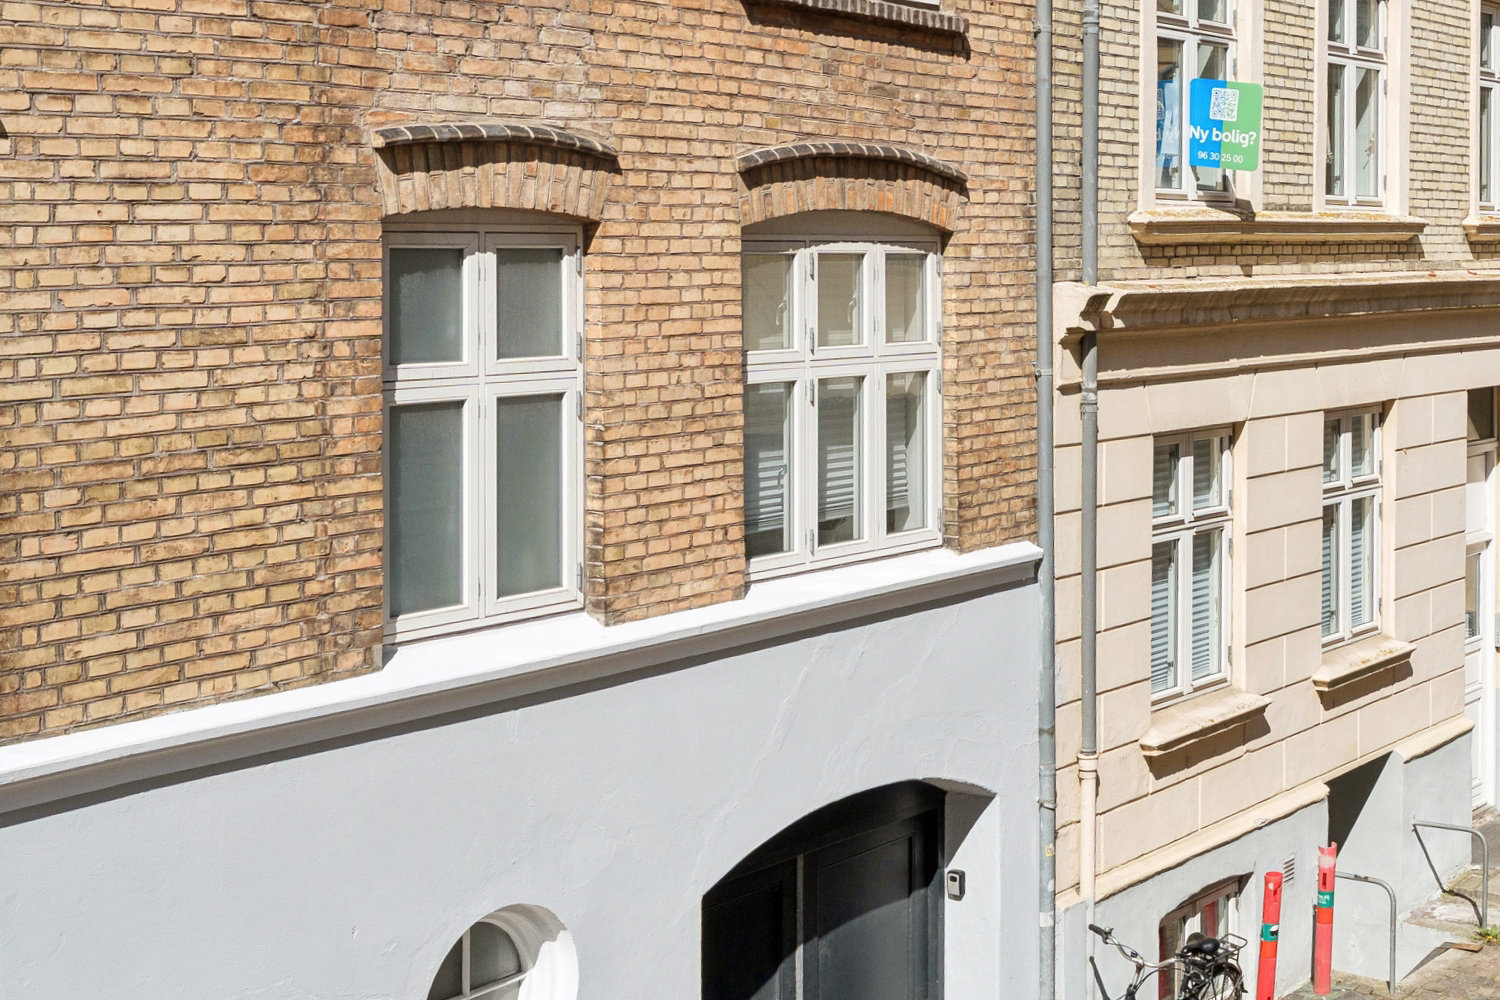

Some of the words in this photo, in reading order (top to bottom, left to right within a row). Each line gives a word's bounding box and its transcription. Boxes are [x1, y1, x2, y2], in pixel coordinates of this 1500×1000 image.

[1189, 125, 1209, 143] Ny
[1212, 127, 1256, 147] bolig?
[1197, 151, 1208, 160] 96
[1209, 152, 1219, 160] 30
[1221, 153, 1231, 162] 25
[1232, 154, 1243, 163] 00
